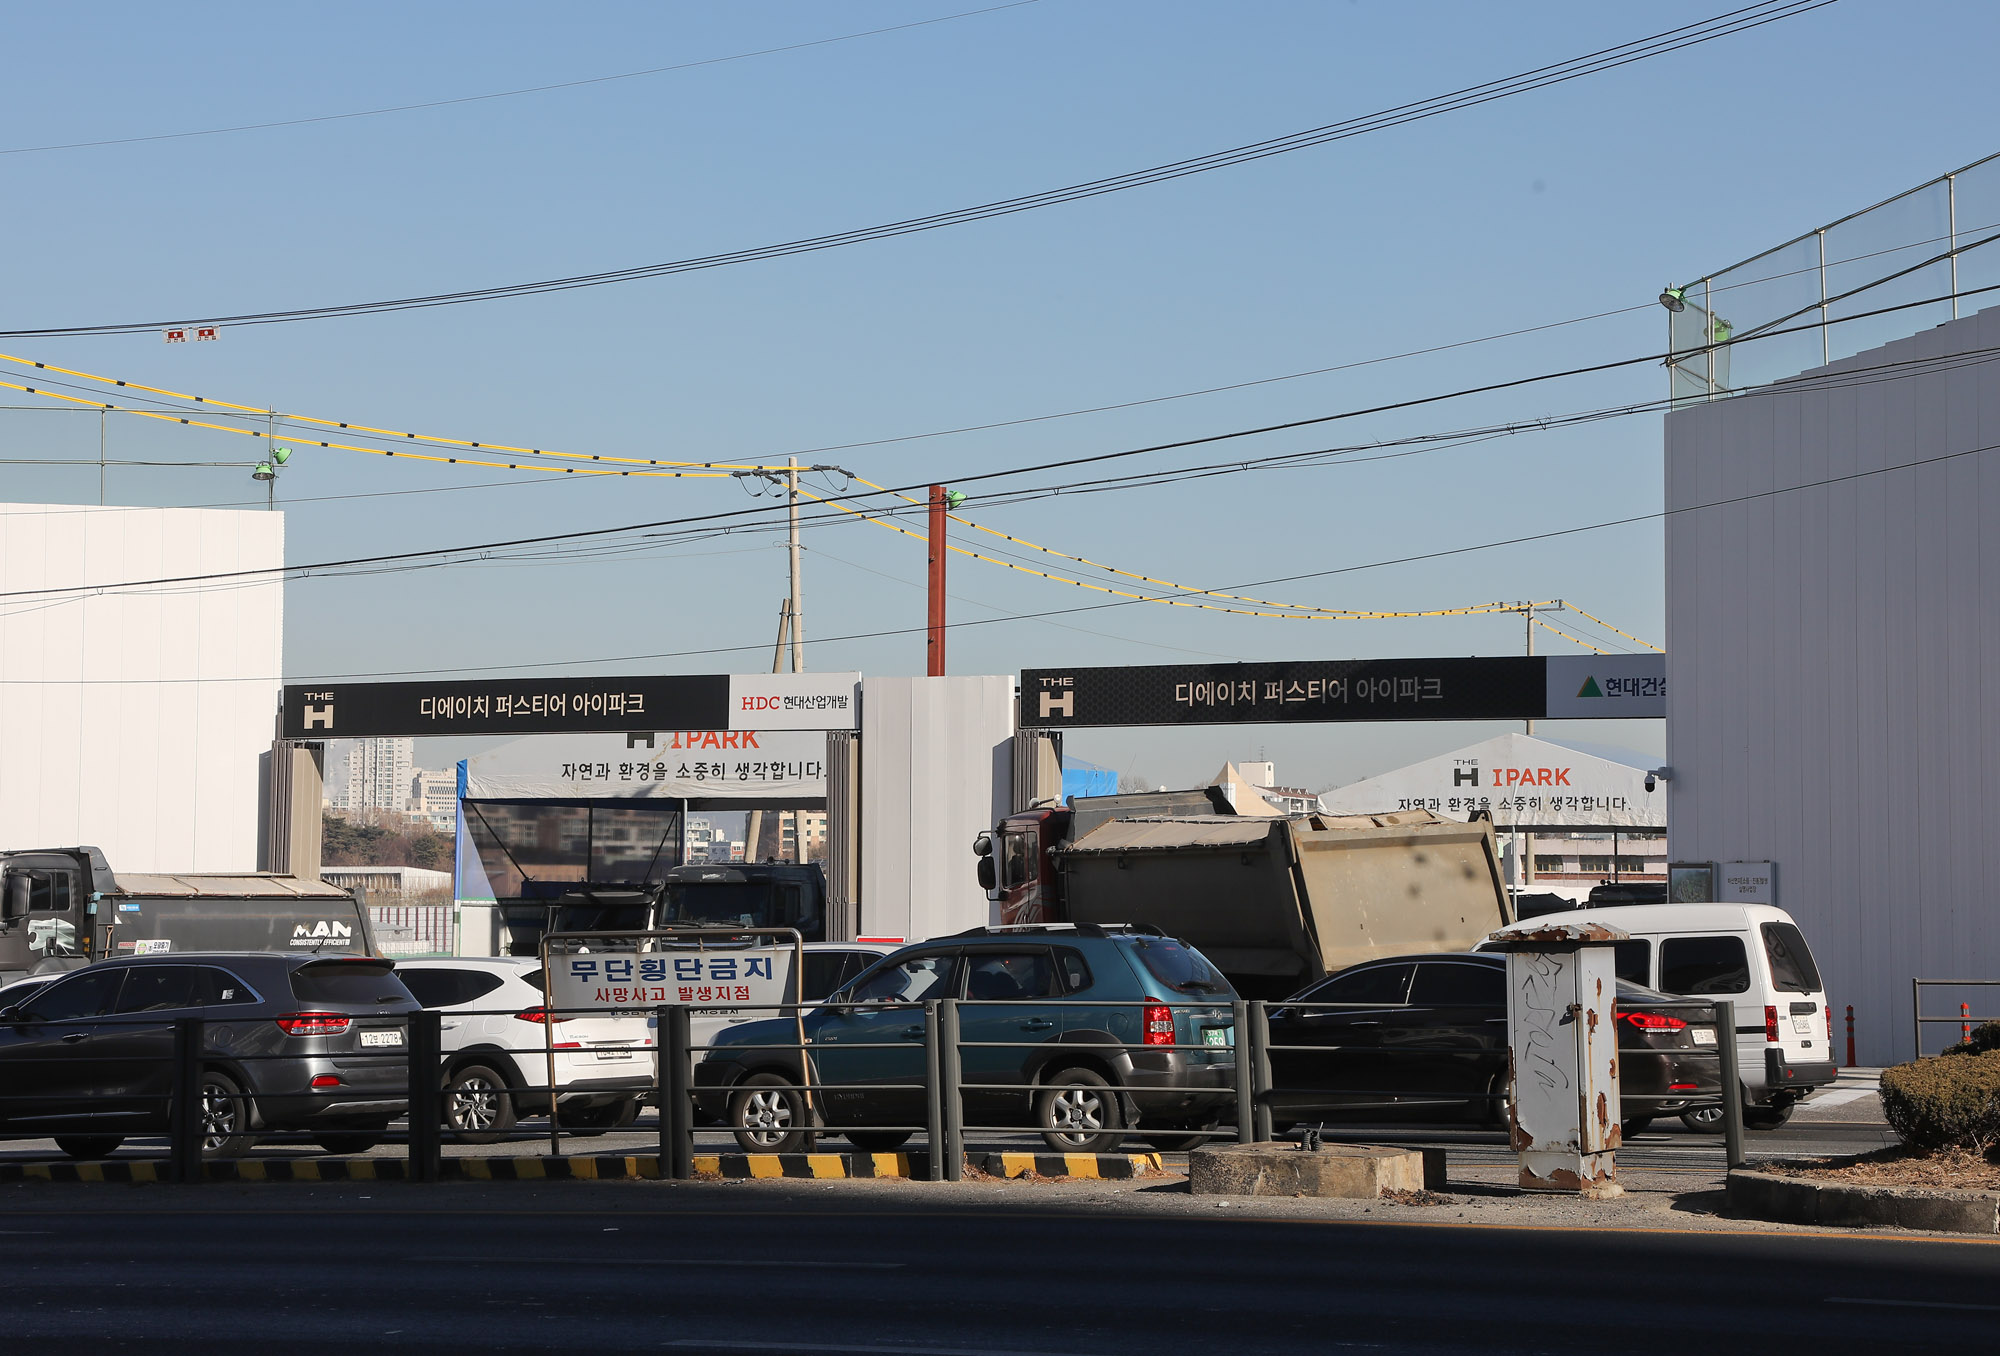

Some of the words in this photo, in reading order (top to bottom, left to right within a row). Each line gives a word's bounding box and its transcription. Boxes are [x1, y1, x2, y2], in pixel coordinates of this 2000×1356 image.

[1039, 677, 1074, 687] THE
[303, 692, 334, 701] THE
[1175, 680, 1257, 707] 디에이치
[1263, 679, 1348, 706] 퍼스티어
[1355, 676, 1443, 703] 아이파크
[420, 695, 490, 720] 디에이치
[495, 693, 567, 718] 퍼스티어
[572, 691, 645, 717] 아이파크
[741, 696, 780, 711] HDC
[783, 694, 849, 710] 현대산업개발
[1039, 691, 1074, 718] H
[303, 704, 334, 729] H
[670, 731, 760, 749] IPARK
[561, 762, 611, 781] 자연과
[618, 762, 668, 781] 환경을
[675, 761, 726, 781] 소중히
[734, 760, 827, 781] 생각합니다.
[1453, 758, 1479, 766] THE
[1453, 768, 1479, 787] H
[1492, 768, 1571, 787] IPARK
[1398, 797, 1441, 812] 자연과
[1447, 797, 1491, 812] 환경을
[1498, 796, 1542, 811] 소중히
[1549, 796, 1632, 812] 생각합니다.
[293, 920, 352, 938] MAN
[323, 938, 347, 946] EFFICIENT
[570, 957, 773, 983] 무단횡단금지
[594, 986, 667, 1003] 사망사고
[678, 985, 750, 1001] 발생지점
[380, 1033, 399, 1044] 2278
